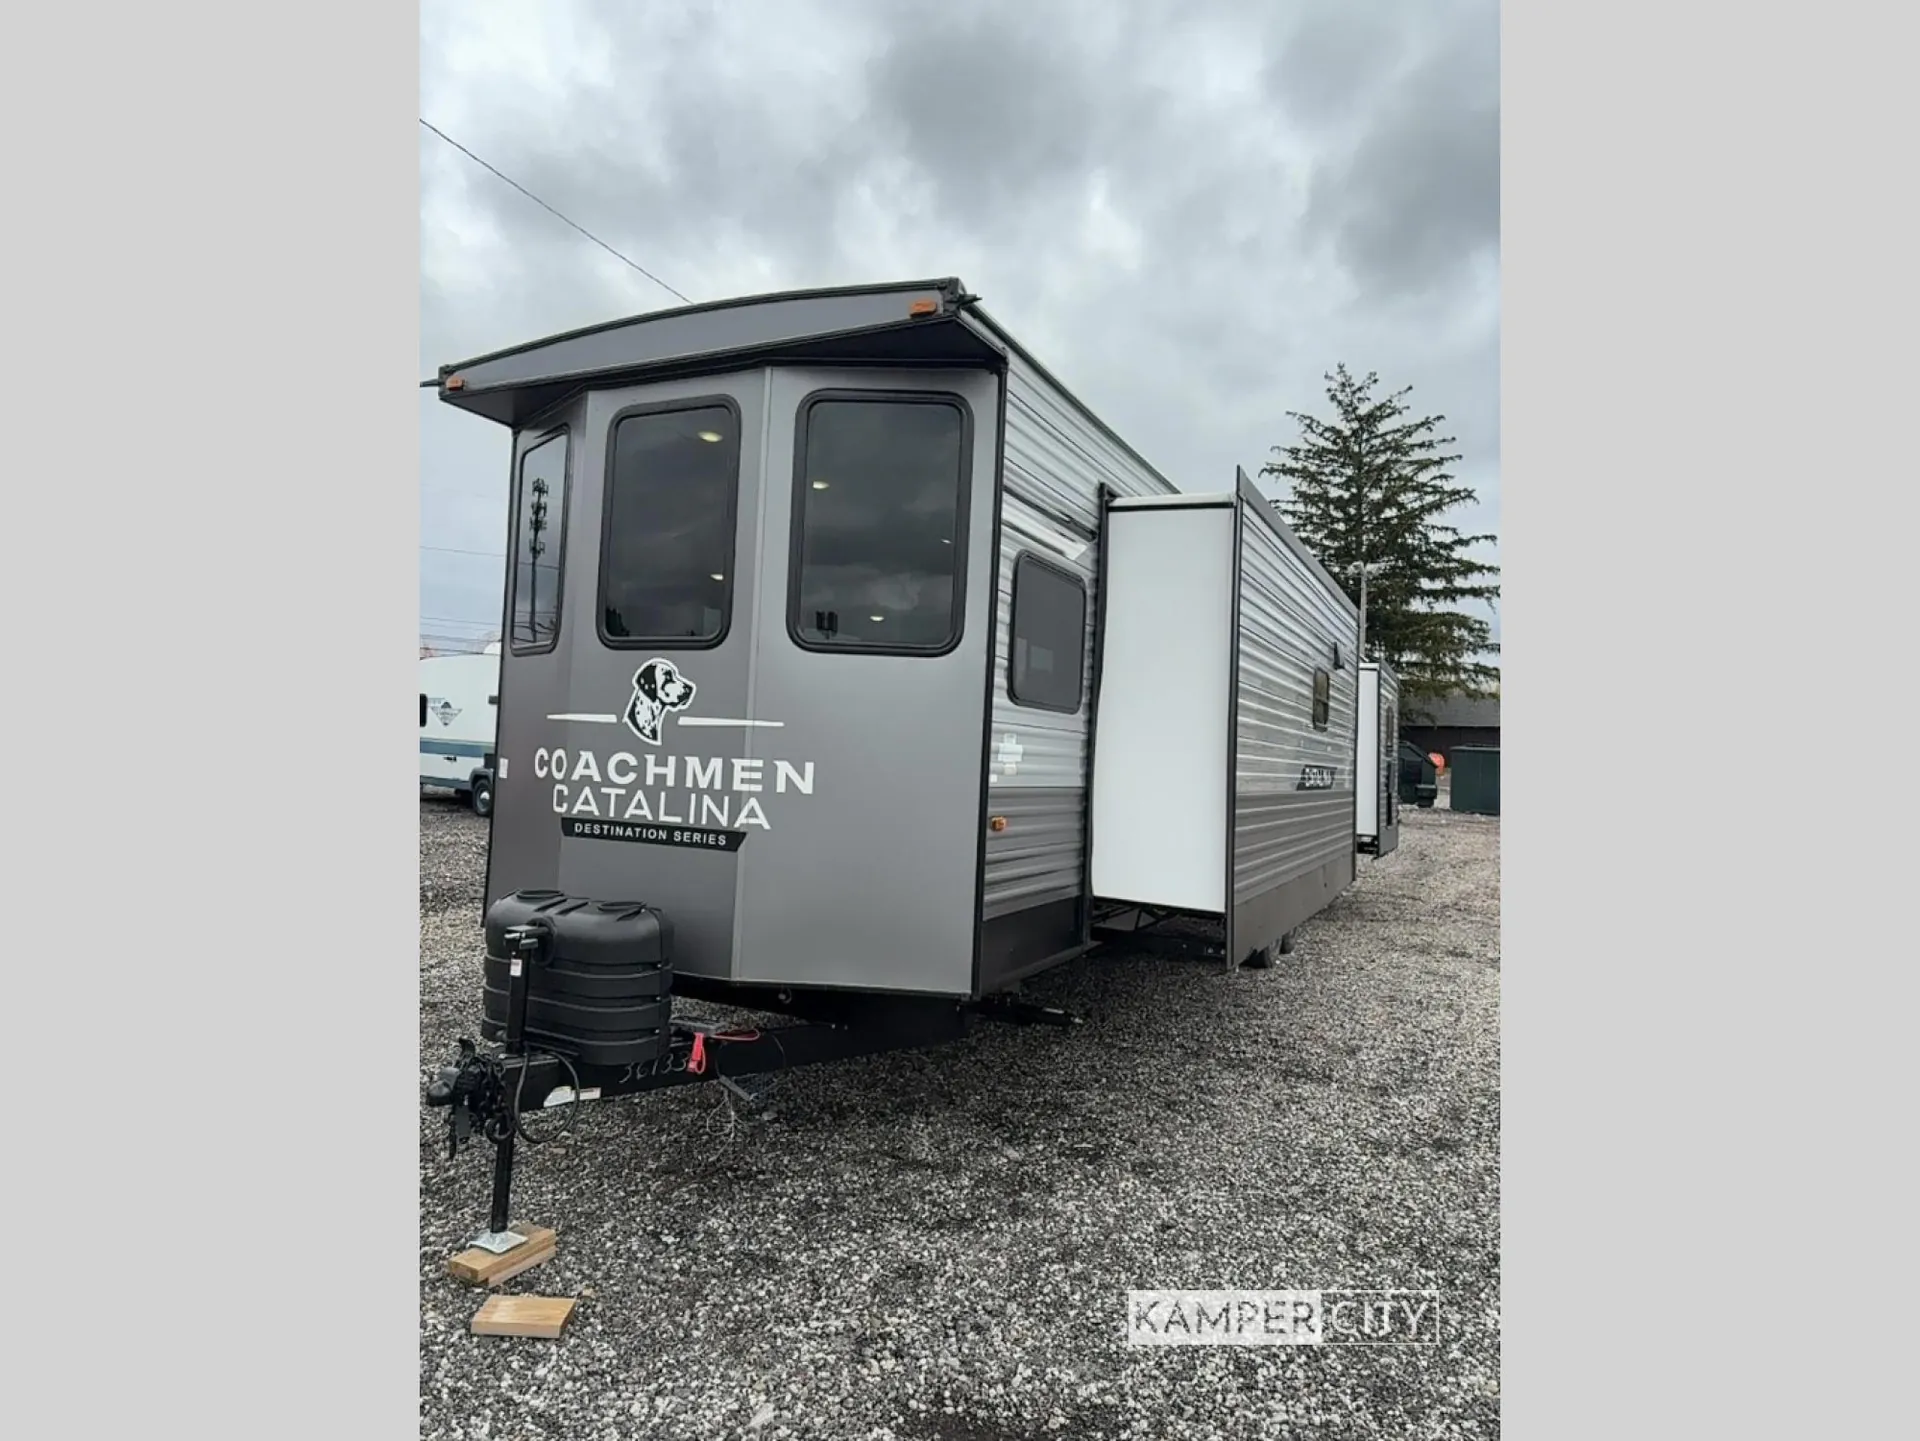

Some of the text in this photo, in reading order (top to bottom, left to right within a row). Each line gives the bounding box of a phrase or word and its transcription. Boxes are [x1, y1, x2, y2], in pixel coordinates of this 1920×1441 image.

[534, 747, 815, 795] COACHMEN
[552, 783, 771, 830] CATALINA
[574, 822, 727, 846] DESTINATION SERIES
